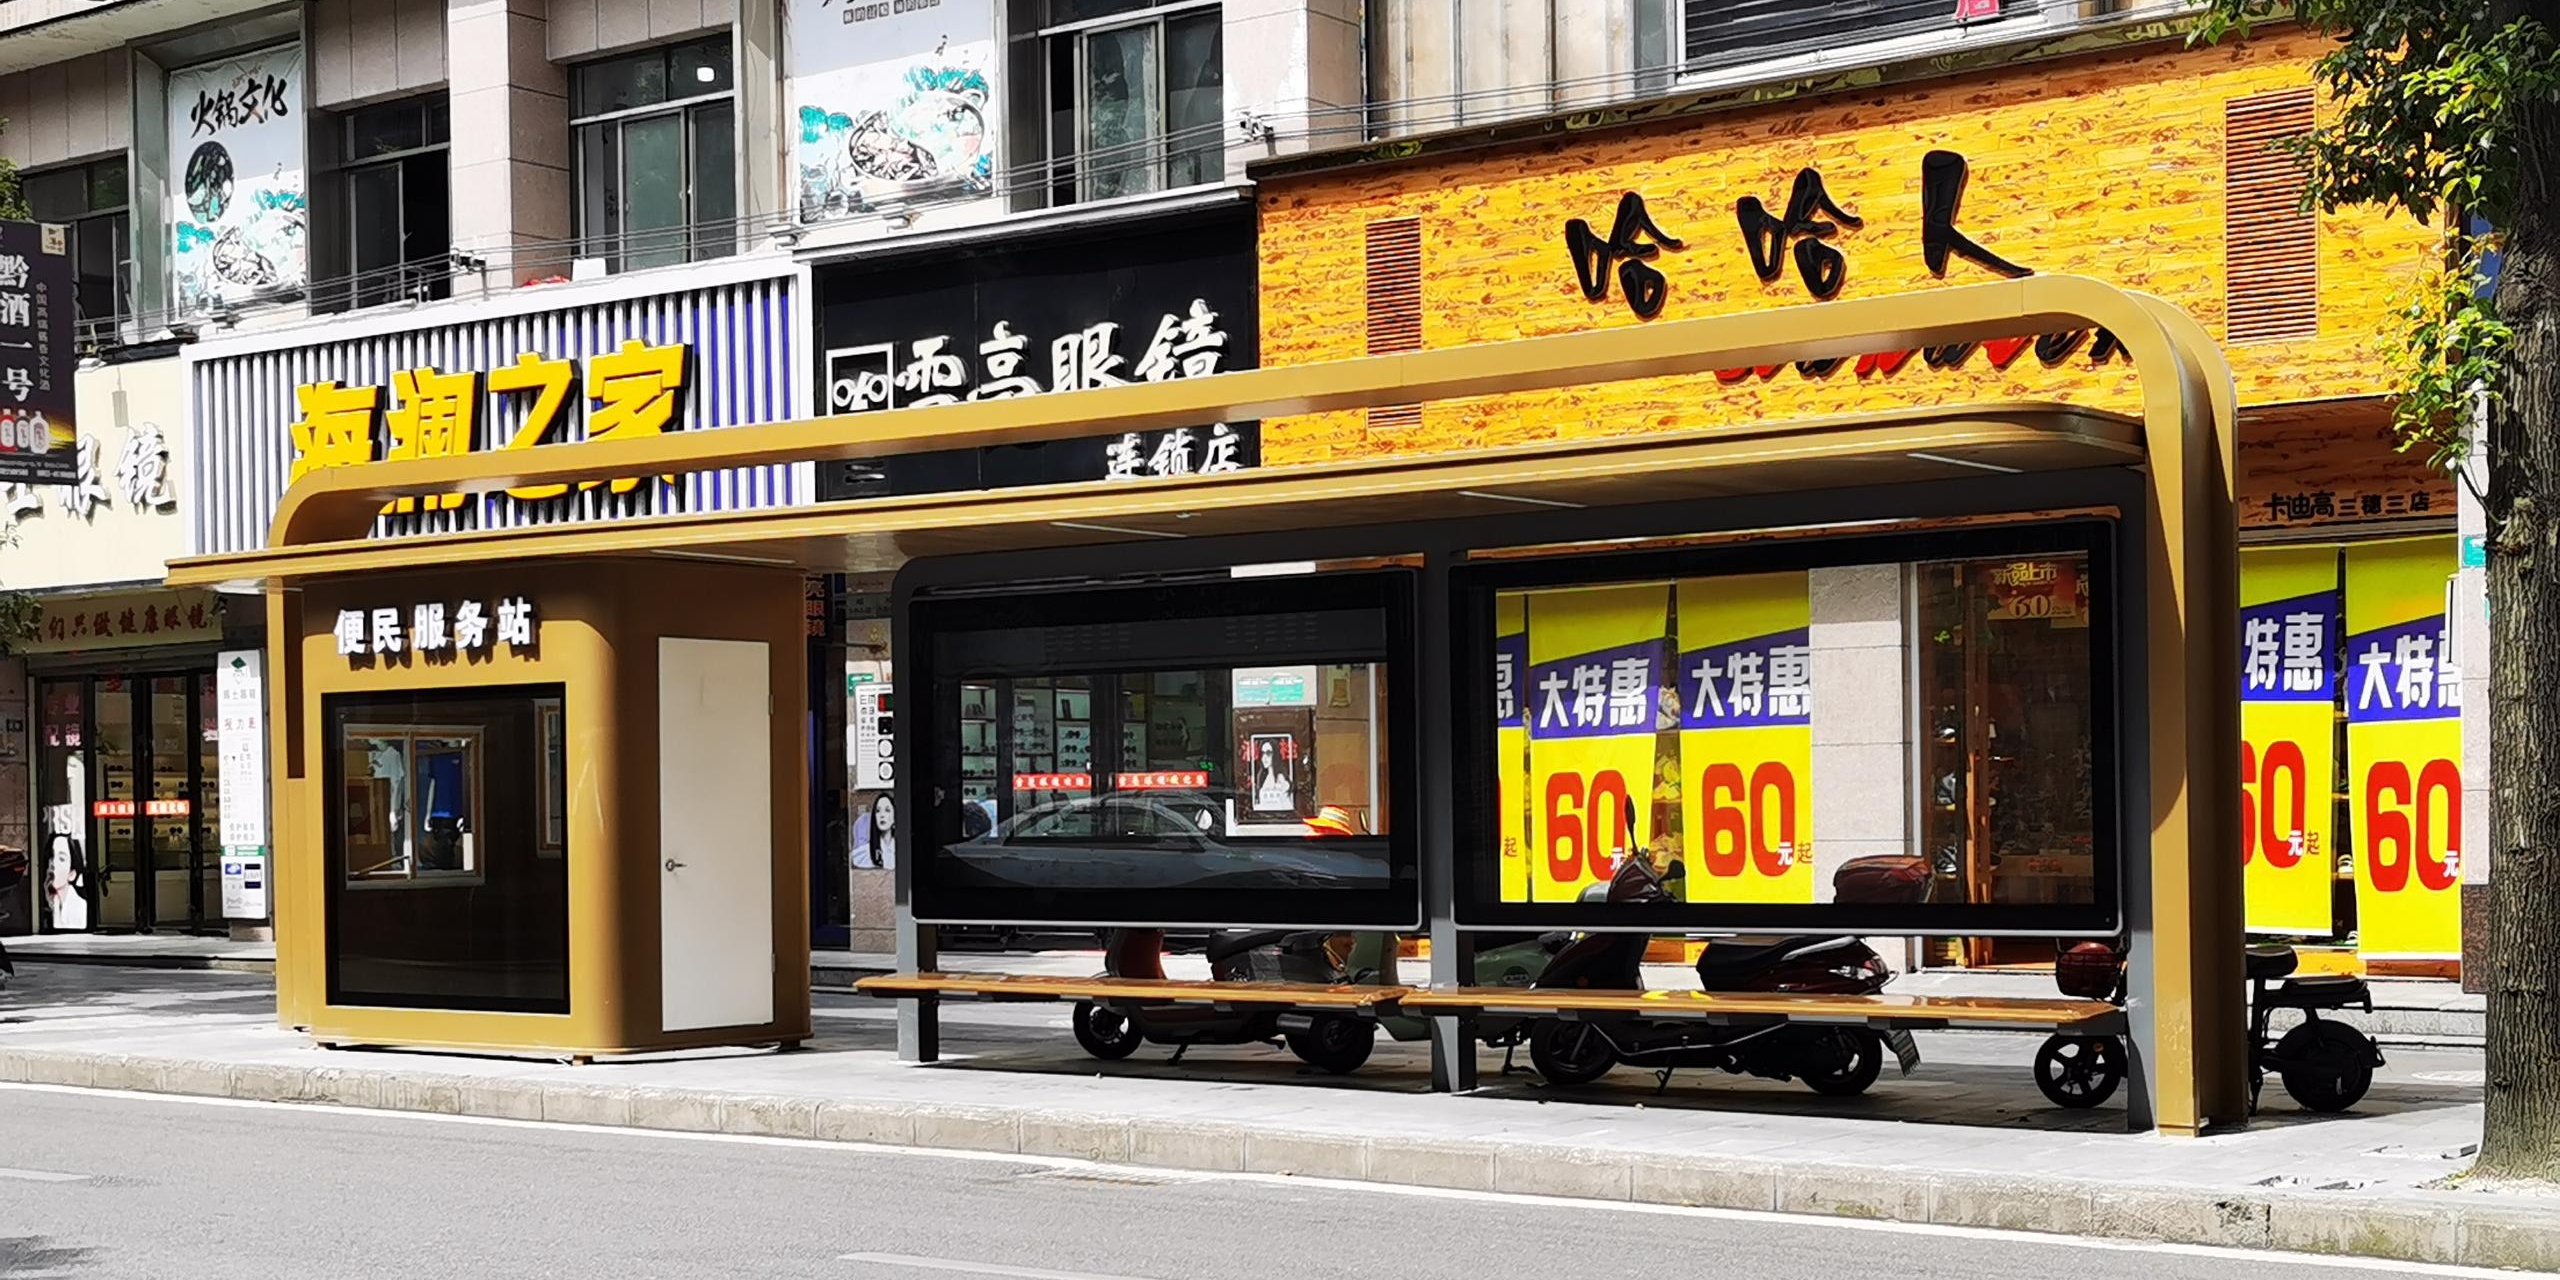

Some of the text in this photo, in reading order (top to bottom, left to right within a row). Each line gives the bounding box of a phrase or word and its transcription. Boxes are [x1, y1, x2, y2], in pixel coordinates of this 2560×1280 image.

[190, 74, 288, 139] 火锅文化
[1565, 149, 2034, 320] 哈哈人
[0, 254, 34, 402] 黔酒一号
[289, 339, 685, 515] 海澜之家
[1104, 422, 1241, 482] 连锁店
[333, 597, 531, 656] 便民服务站
[2009, 594, 2050, 618] 60
[1538, 657, 1650, 729] 大特惠
[1692, 644, 1811, 718] 大特惠
[1545, 769, 1629, 883] 60
[1701, 761, 1796, 877] 60
[2366, 758, 2462, 893] 60
